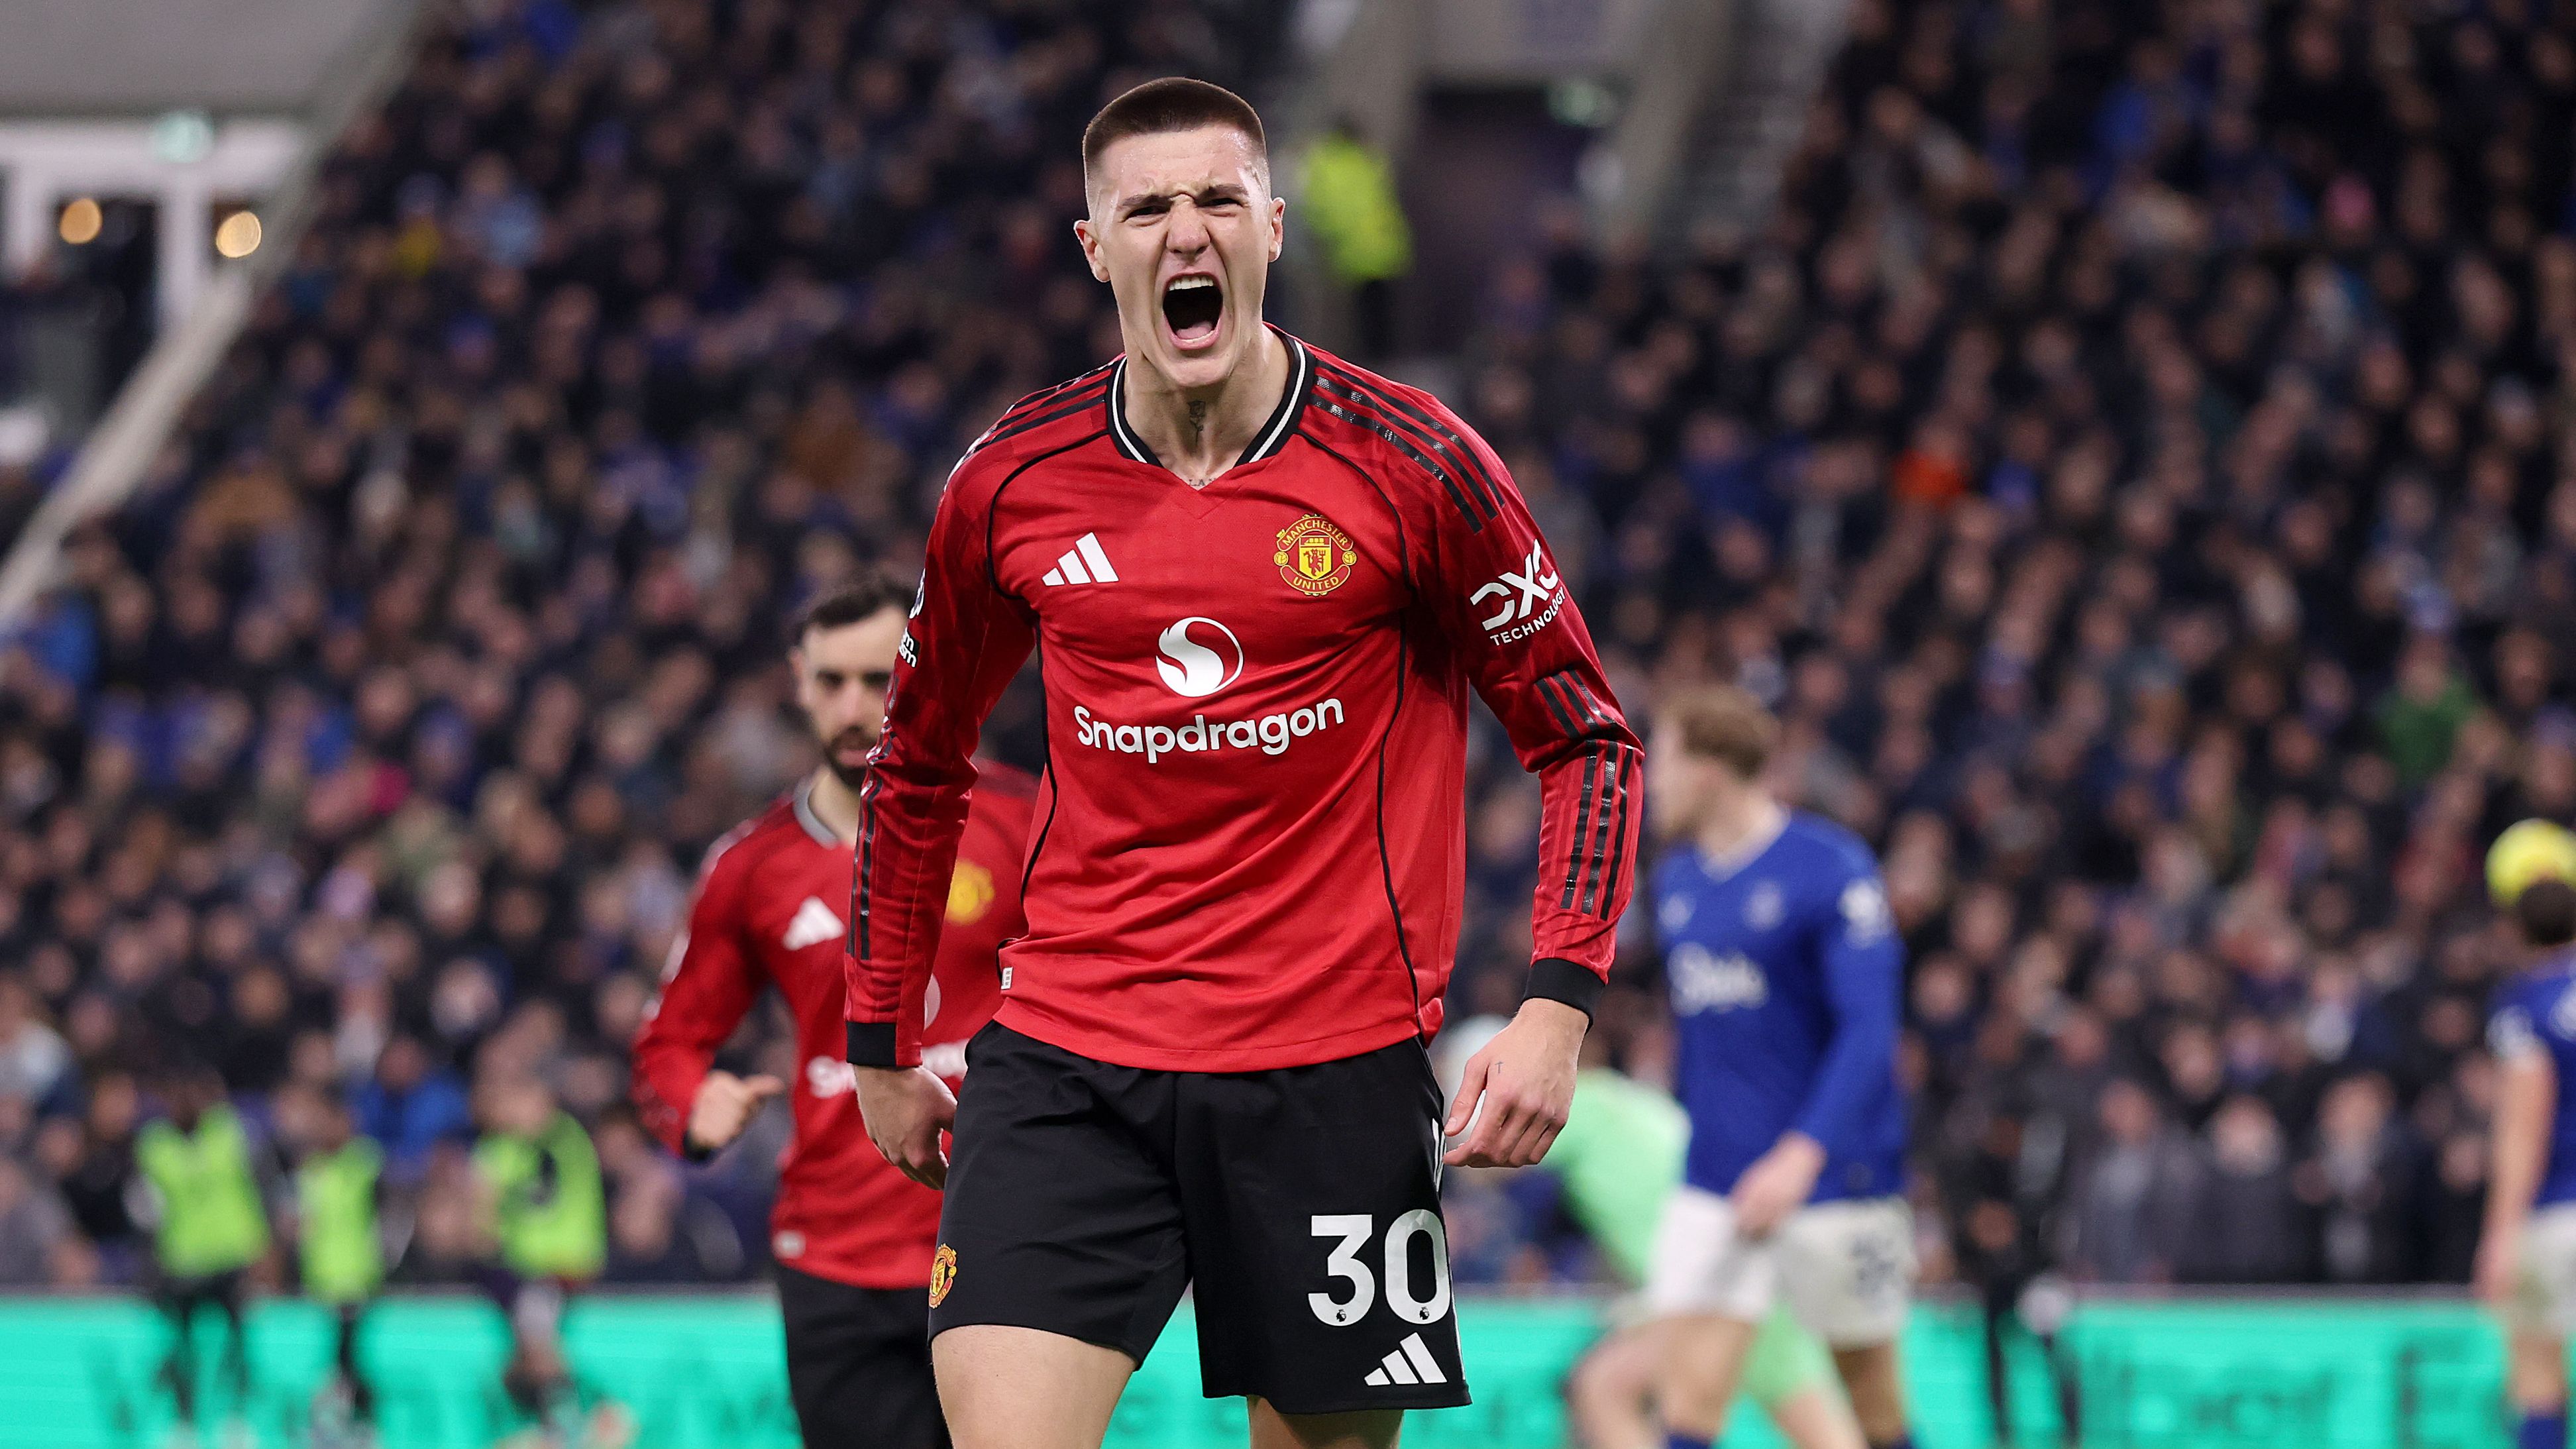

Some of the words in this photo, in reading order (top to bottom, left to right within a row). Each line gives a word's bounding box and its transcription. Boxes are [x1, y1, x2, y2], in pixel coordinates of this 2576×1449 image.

[1282, 519, 1348, 547] MANCHESTER
[1293, 576, 1340, 590] UNITED
[1470, 538, 1559, 631] DXC
[1489, 586, 1566, 647] TECHNOLOGY
[1074, 698, 1344, 764] Snapdragon
[1308, 1208, 1451, 1326] 30
